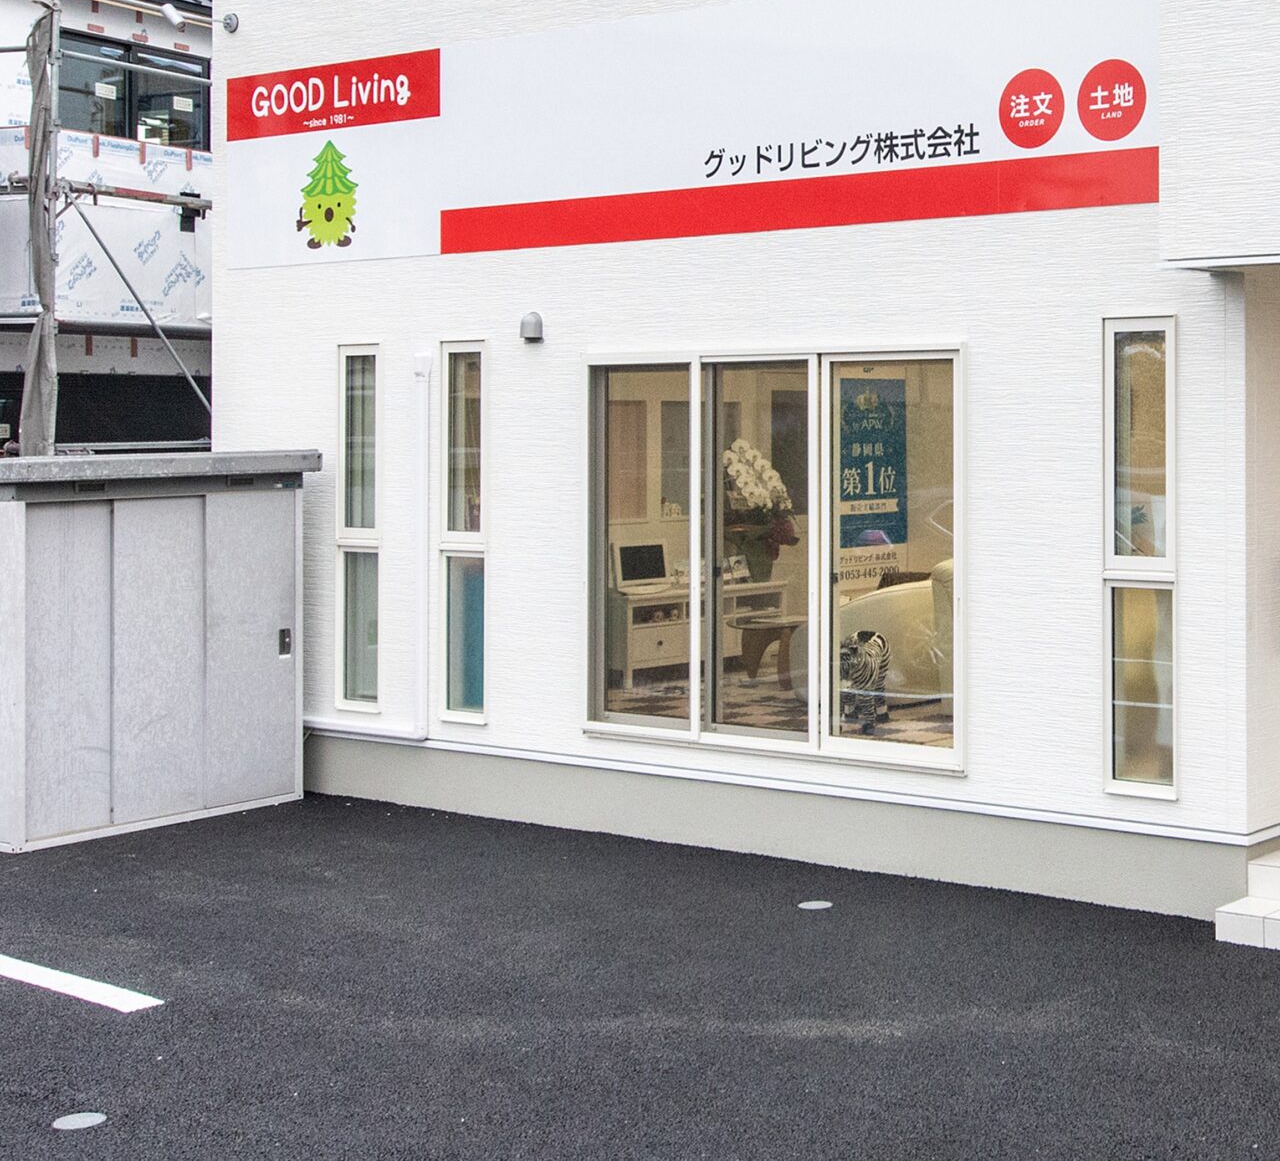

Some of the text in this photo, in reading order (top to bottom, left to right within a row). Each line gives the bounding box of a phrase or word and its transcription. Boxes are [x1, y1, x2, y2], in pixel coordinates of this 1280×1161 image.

[252, 73, 411, 118] GOOD Living
[1010, 92, 1053, 118] 注文
[1089, 82, 1134, 110] 土地
[1018, 118, 1045, 128] ORDER
[1101, 111, 1123, 120] LAND
[704, 123, 980, 179] グッドリビング株式会社
[842, 461, 896, 495] 第1位
